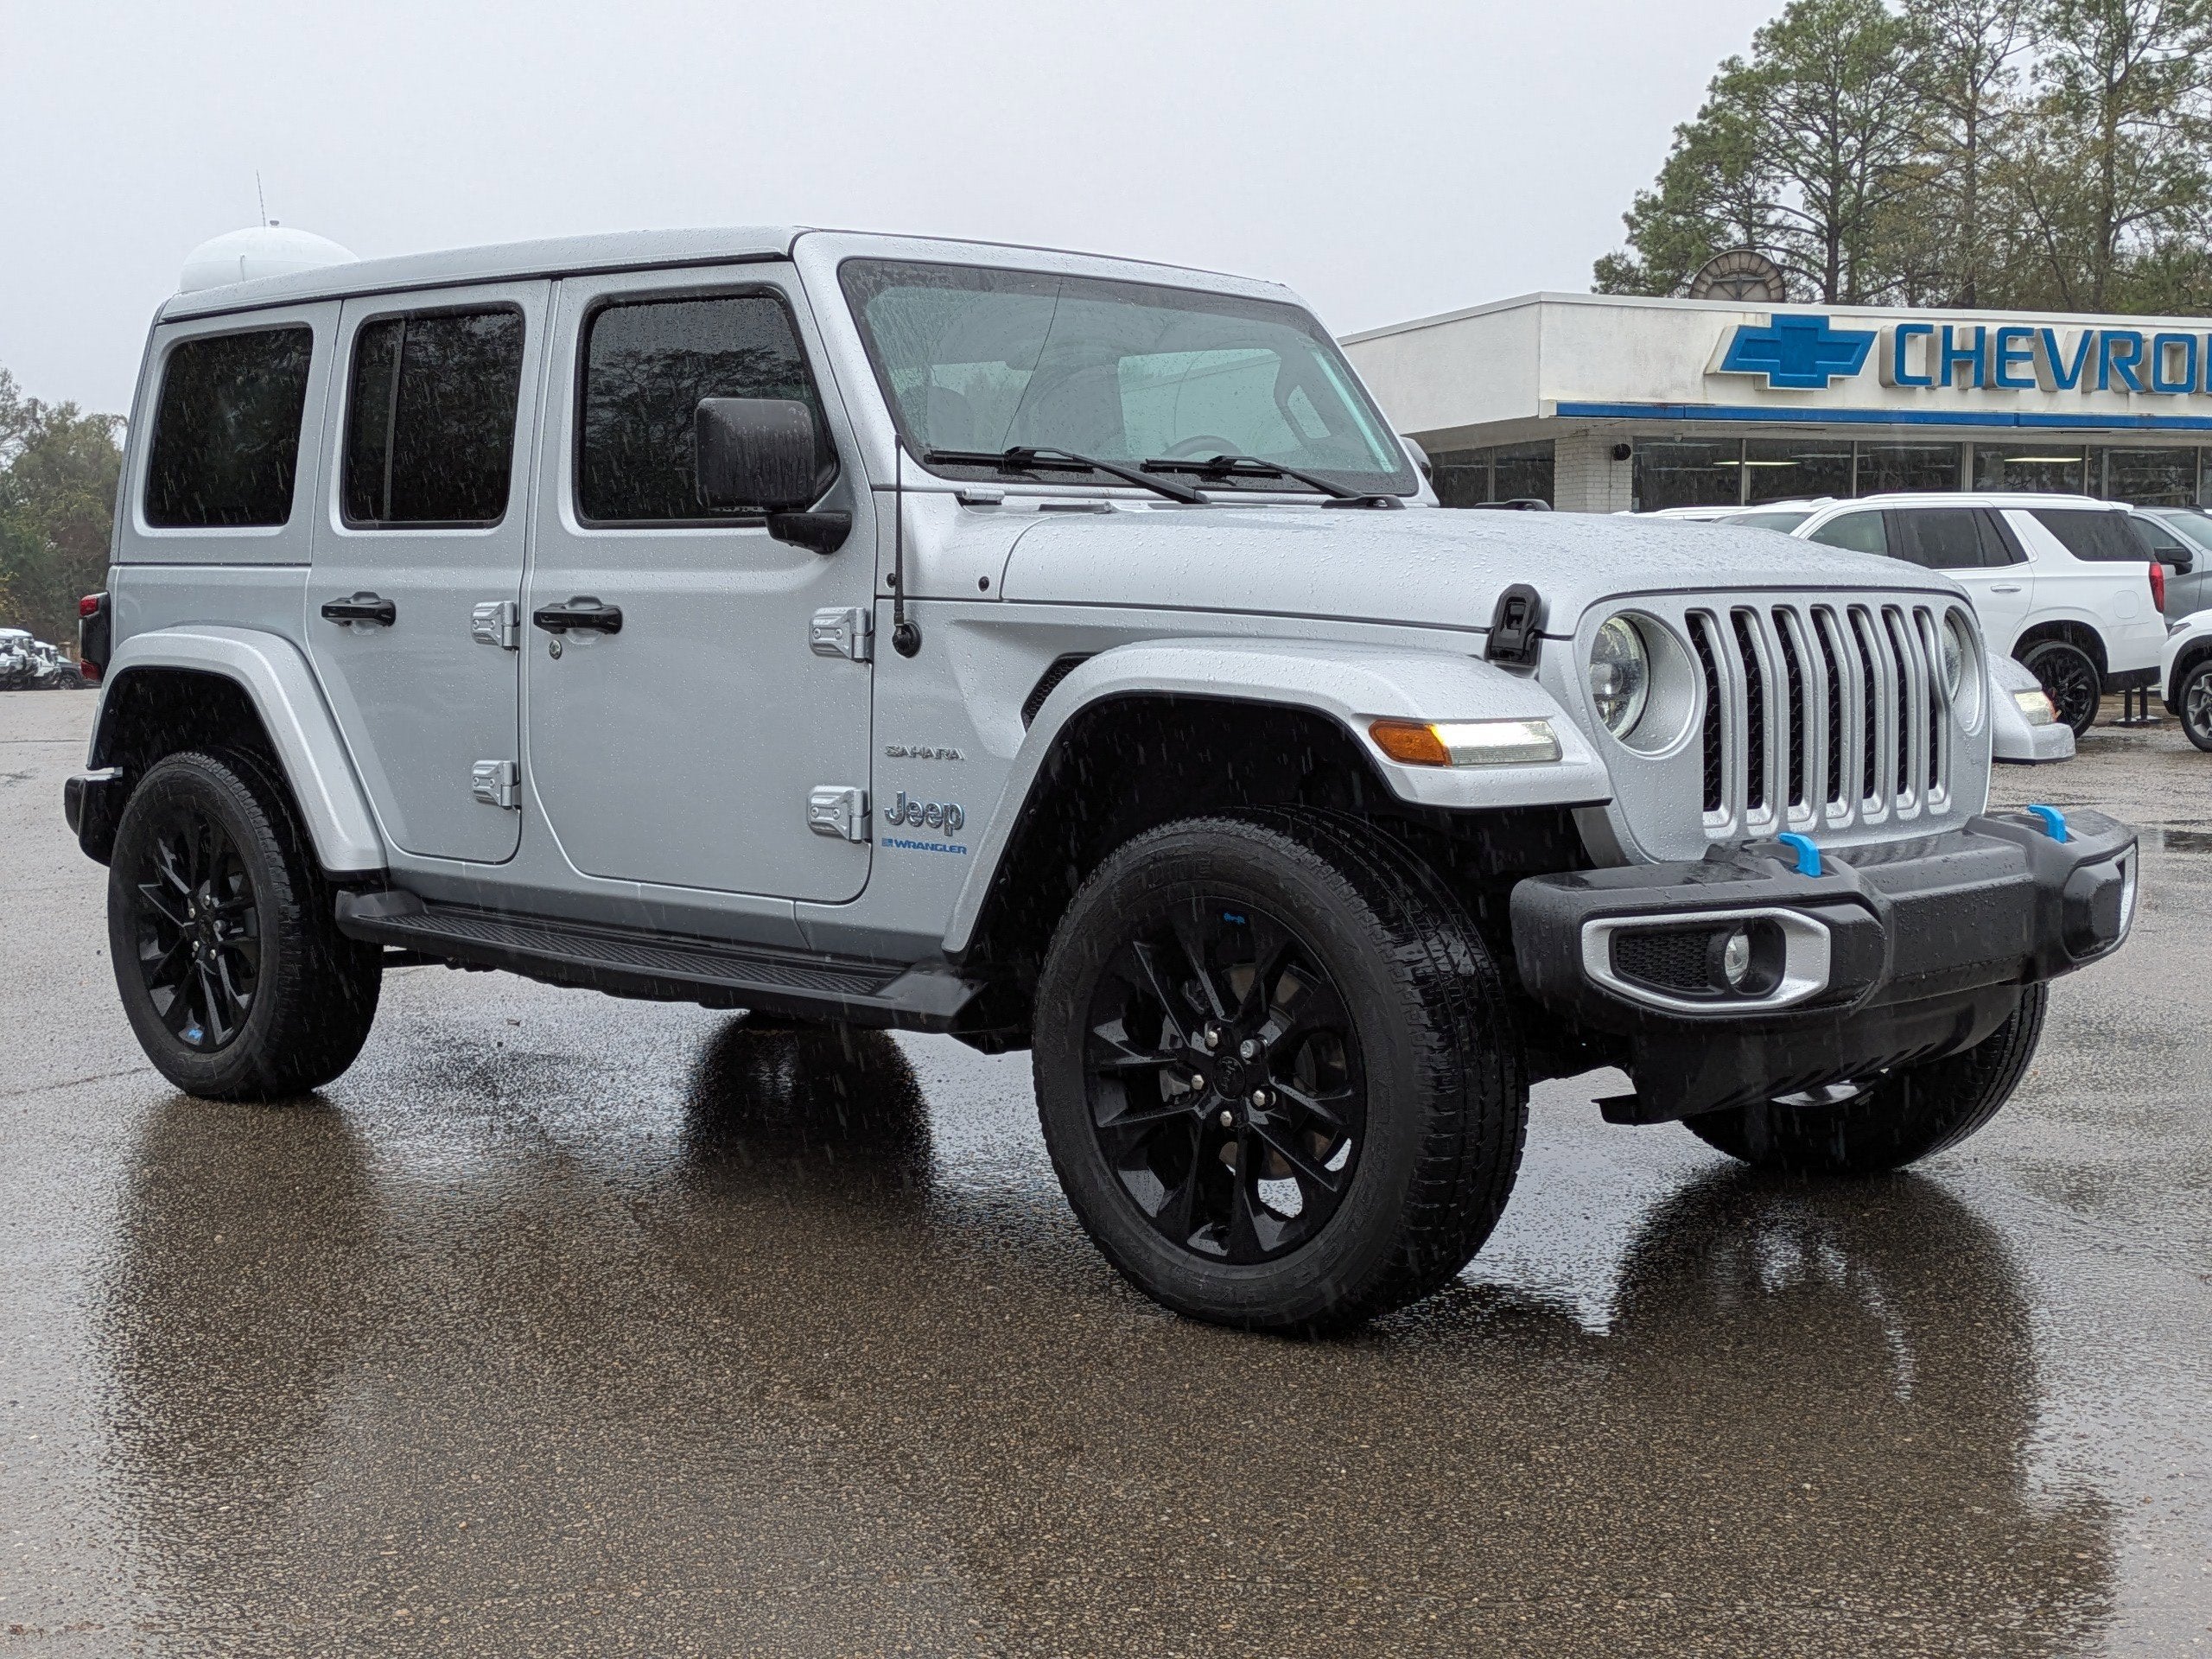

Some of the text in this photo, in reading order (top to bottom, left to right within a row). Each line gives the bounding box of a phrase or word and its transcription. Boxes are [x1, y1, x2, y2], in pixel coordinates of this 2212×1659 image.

[1893, 323, 2212, 394] CHEVRO
[884, 744, 966, 761] SAHARA
[884, 791, 965, 837] Jeep
[894, 839, 968, 855] WRANGLER
